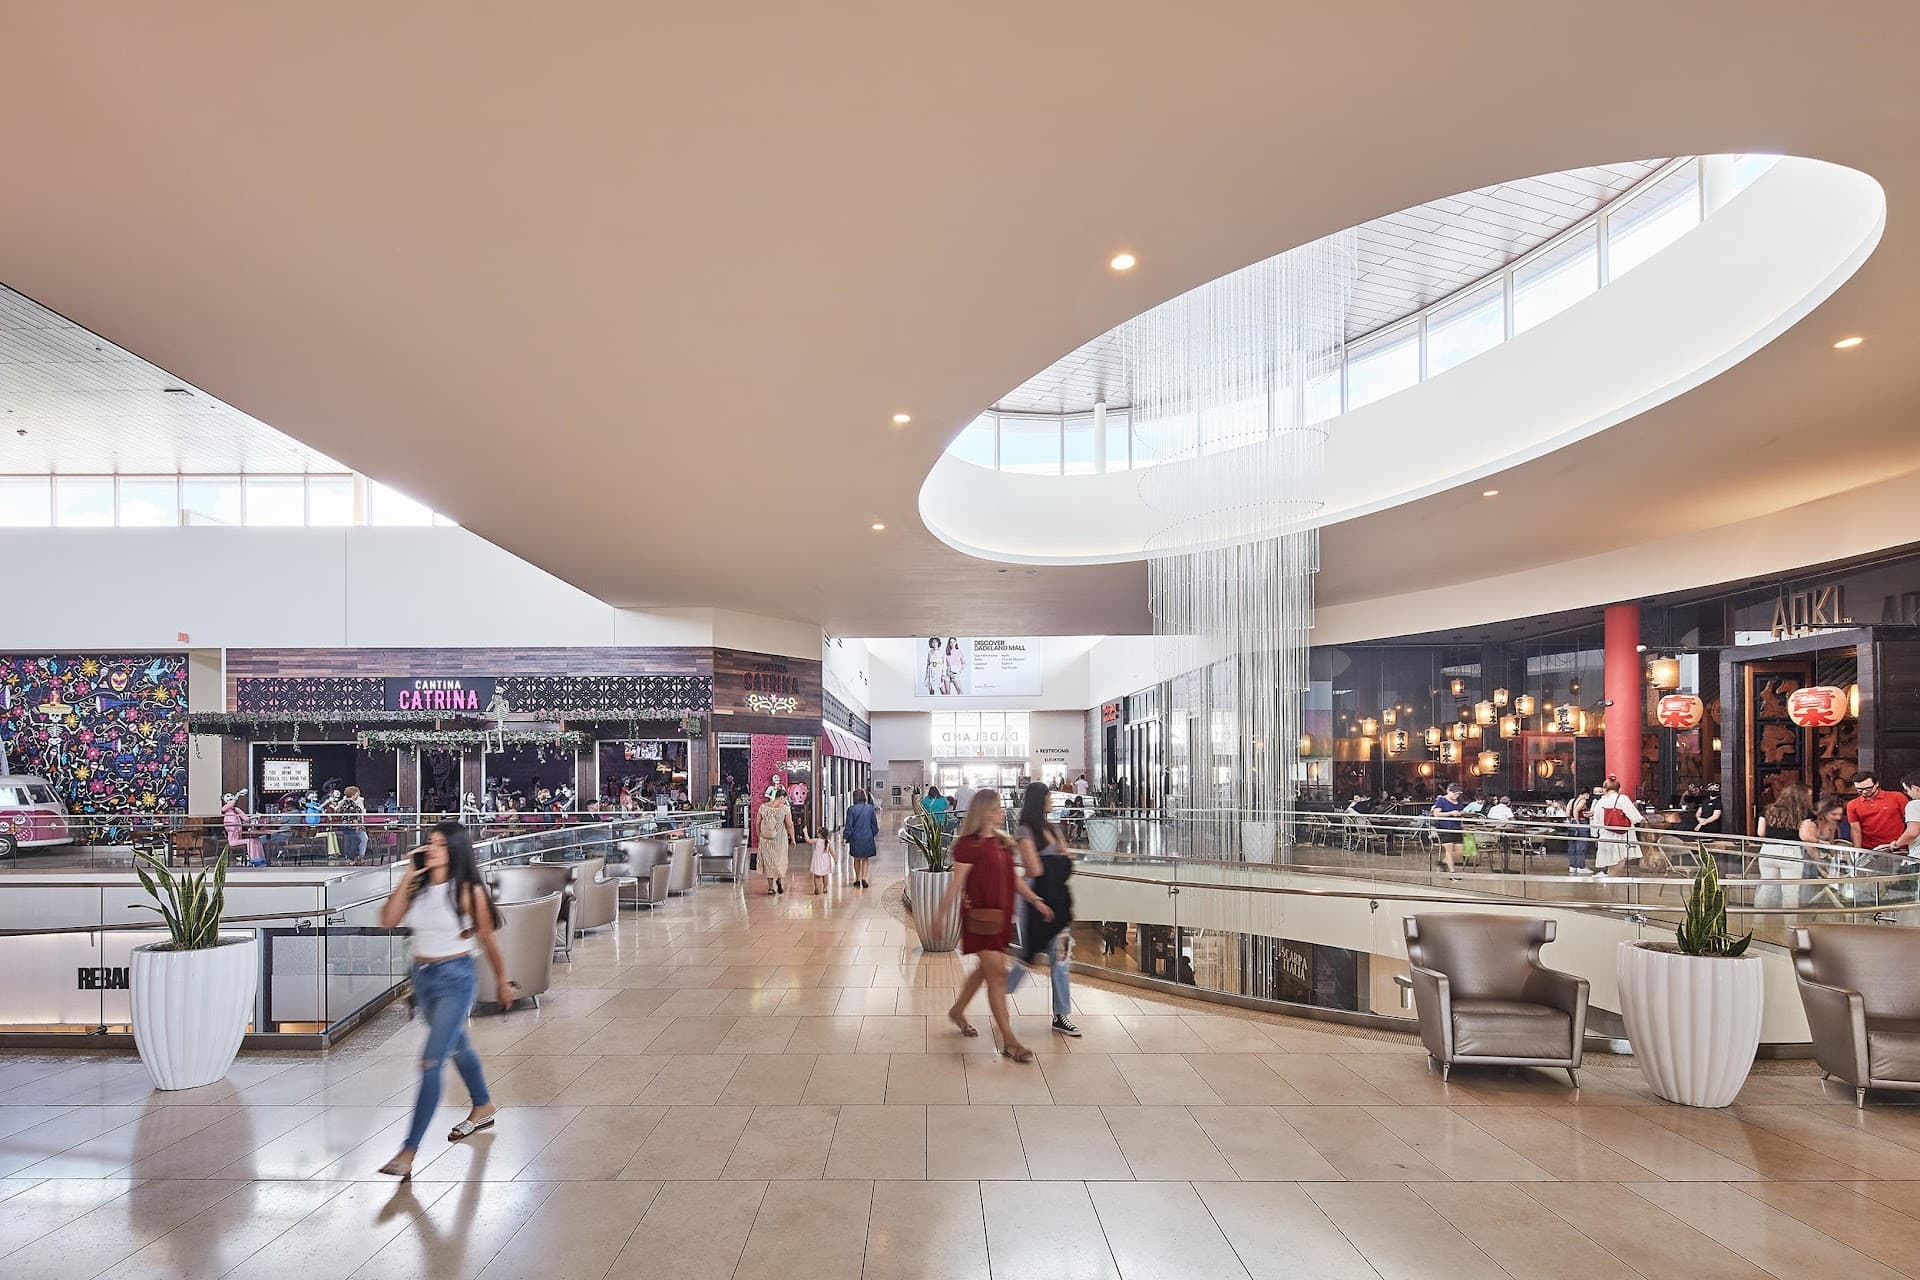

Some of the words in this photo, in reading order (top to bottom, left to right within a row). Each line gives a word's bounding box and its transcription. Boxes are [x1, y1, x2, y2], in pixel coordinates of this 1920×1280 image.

[1770, 585, 1843, 638] AOKI
[415, 680, 462, 690] CANTINA
[399, 690, 479, 710] CATRINA
[1793, 688, 1836, 726] 青木
[1281, 948, 1309, 970] SCARPA
[1283, 958, 1306, 982] ITALIA
